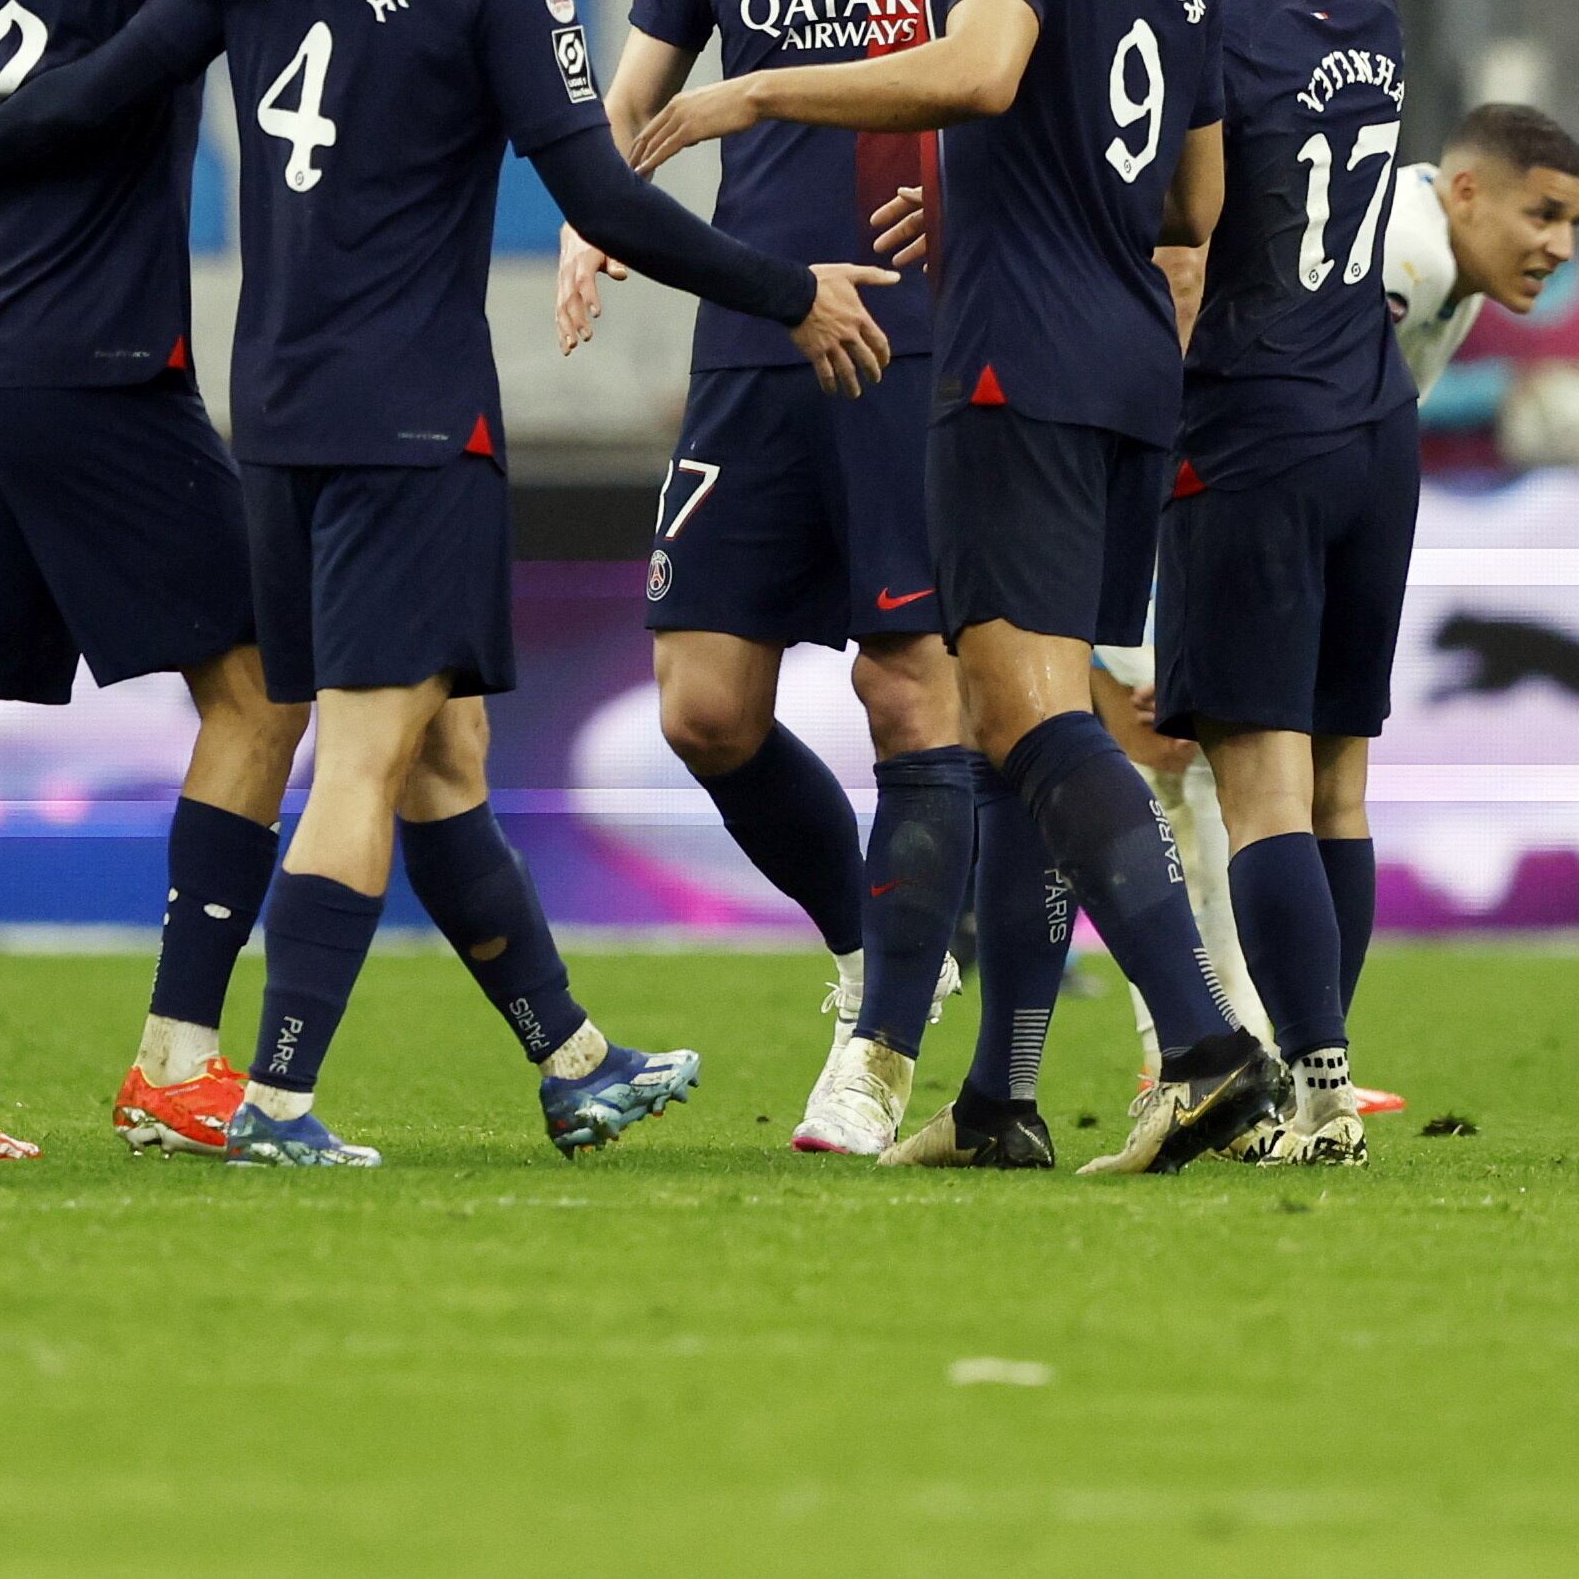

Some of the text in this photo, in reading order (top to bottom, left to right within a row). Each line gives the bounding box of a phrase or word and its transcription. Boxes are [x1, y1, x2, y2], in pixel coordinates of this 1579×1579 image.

[781, 17, 919, 51] AIRWAYS
[257, 20, 337, 193] 4
[1105, 18, 1165, 183] 9
[1297, 48, 1405, 113] VITINHA
[1296, 120, 1401, 291] 17
[655, 458, 721, 542] 7
[1148, 799, 1184, 884] PARIS
[1043, 868, 1069, 944] PARIS
[508, 997, 551, 1052] PARIS
